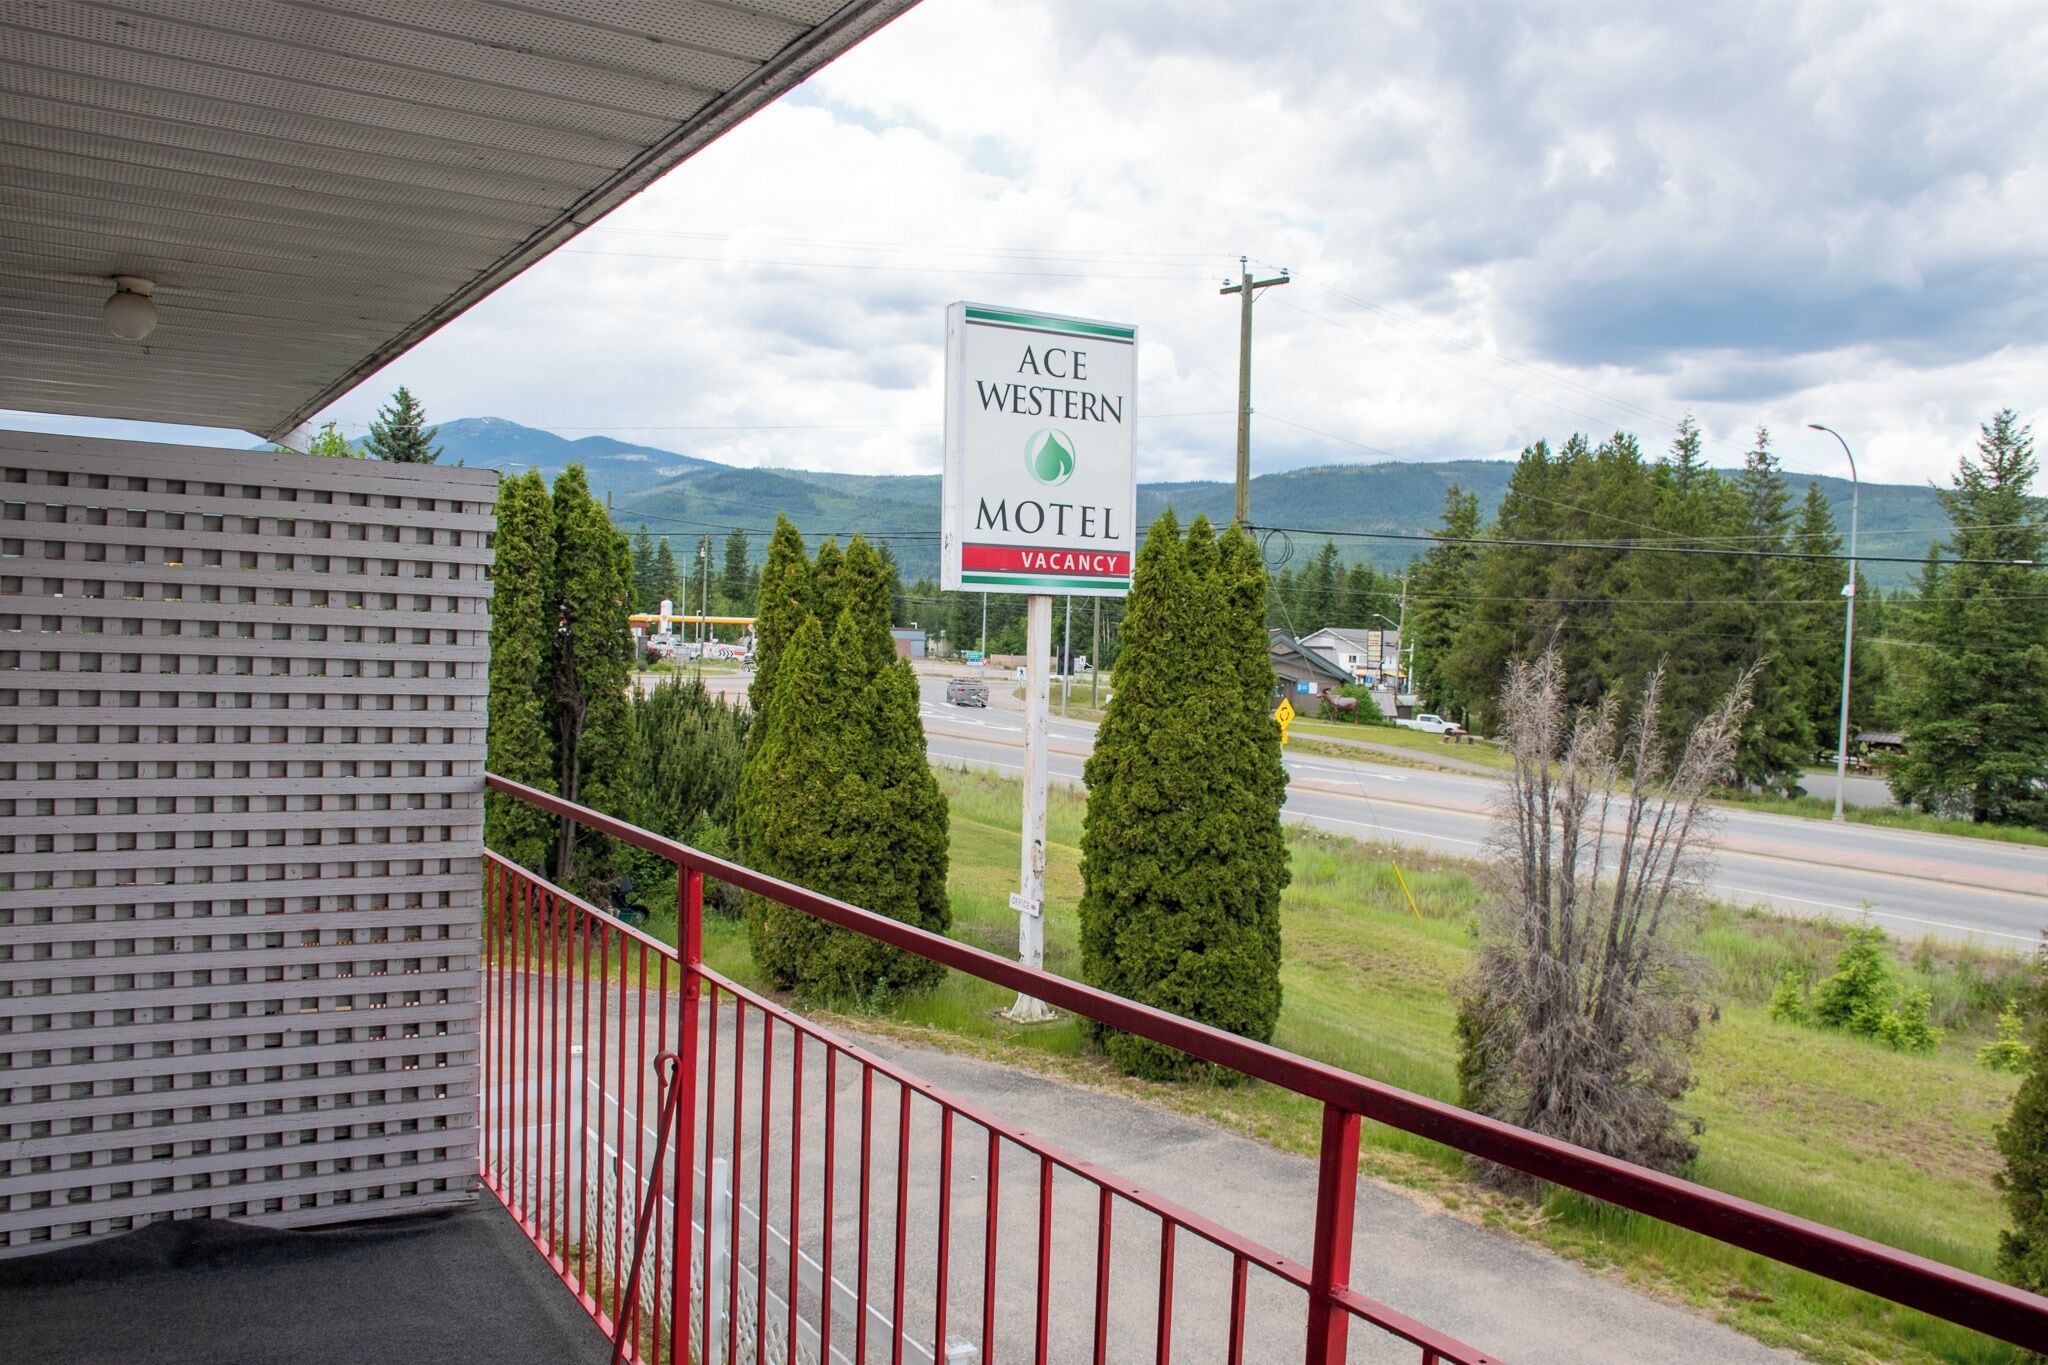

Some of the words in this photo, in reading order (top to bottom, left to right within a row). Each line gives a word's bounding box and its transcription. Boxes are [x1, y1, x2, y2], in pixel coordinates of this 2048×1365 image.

[1016, 344, 1087, 381] ACE
[975, 380, 1123, 424] WESTERN
[975, 497, 1120, 540] MOTEL
[1021, 551, 1119, 572] VACANCY
